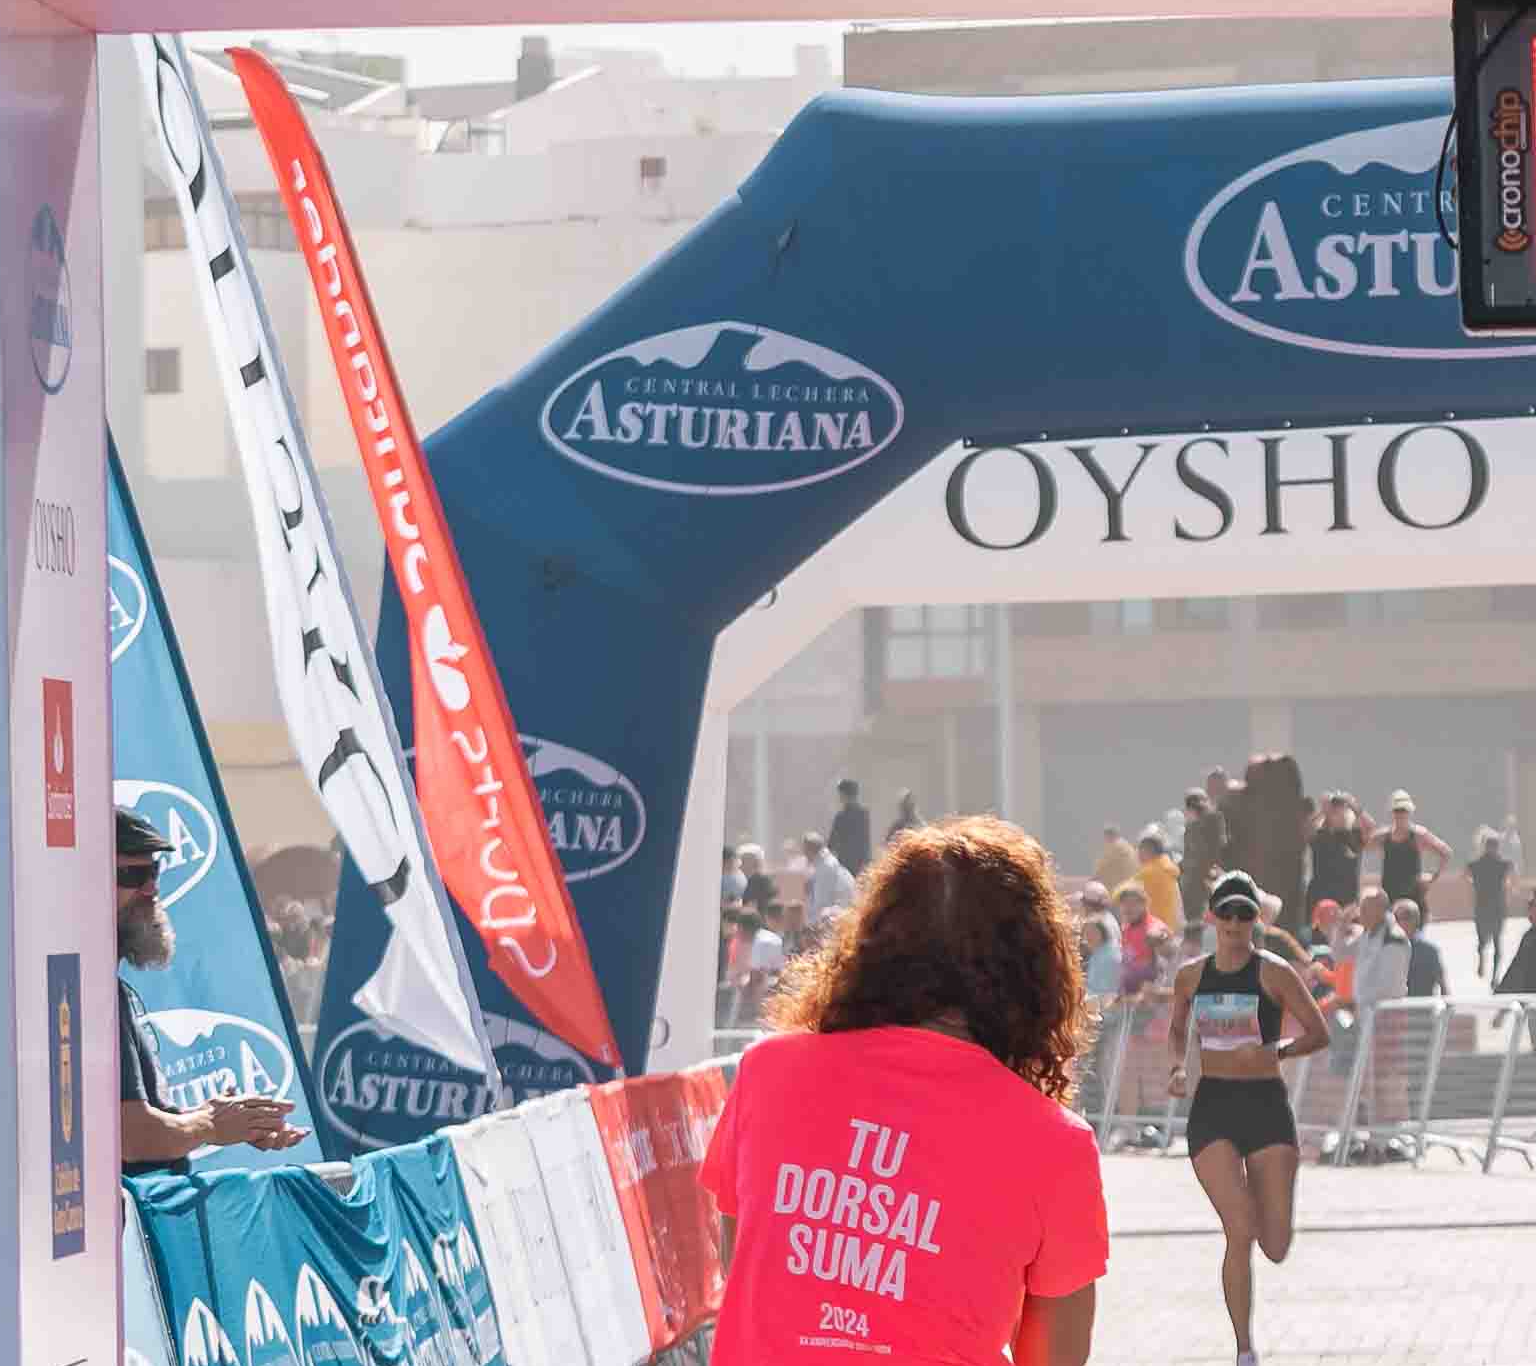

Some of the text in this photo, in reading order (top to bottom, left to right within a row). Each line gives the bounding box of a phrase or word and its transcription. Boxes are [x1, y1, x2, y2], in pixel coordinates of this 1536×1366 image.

[1489, 89, 1527, 231] cronochip
[561, 381, 877, 454] ASTURIANA
[944, 423, 1492, 553] OYSHO
[848, 1116, 911, 1177] TU
[773, 1163, 944, 1255] DORSAL
[786, 1223, 909, 1303] SUMA
[818, 1302, 871, 1340] 2024
